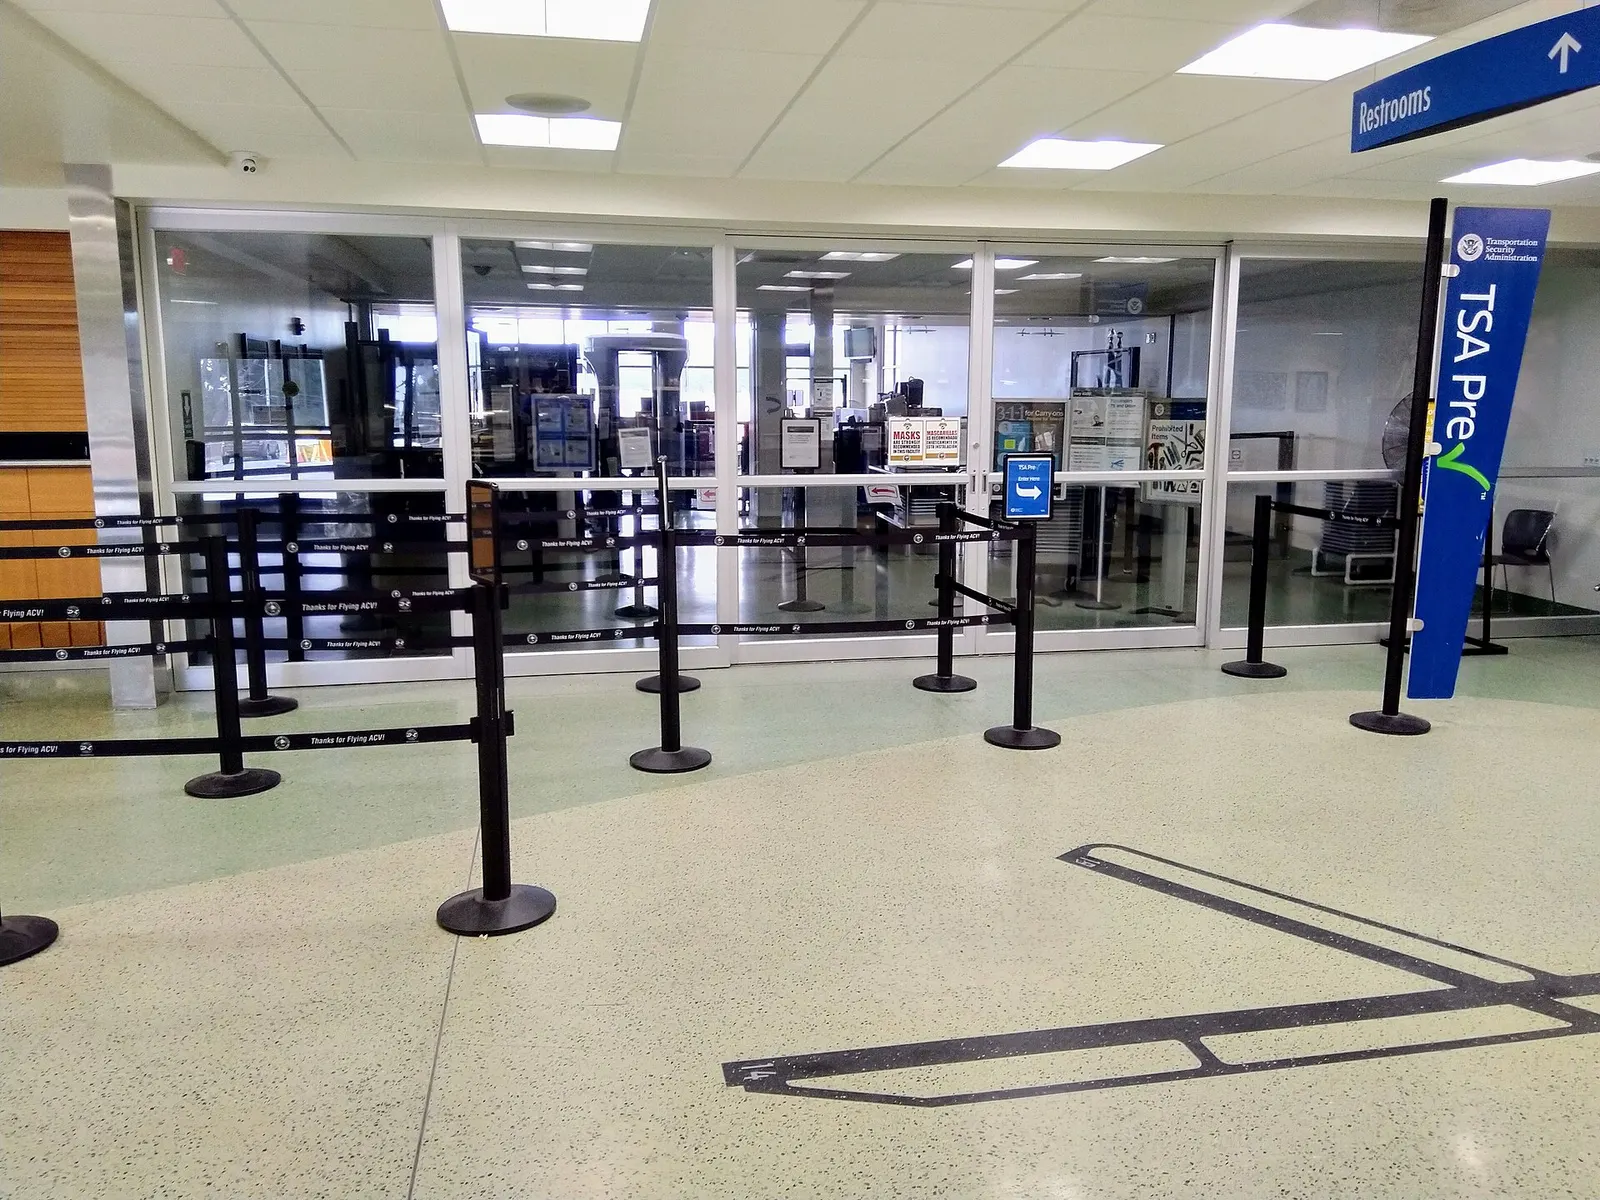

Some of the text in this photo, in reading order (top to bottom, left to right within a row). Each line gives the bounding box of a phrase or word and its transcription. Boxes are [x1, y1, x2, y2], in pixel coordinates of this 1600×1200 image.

[1359, 86, 1431, 134] Restrooms
[1486, 237, 1538, 247] Transportation
[1485, 246, 1516, 255] Security
[1484, 253, 1538, 262] Administration
[1454, 284, 1496, 363] TSA
[1446, 375, 1487, 440] Pre
[996, 405, 1025, 421] 3-1-1
[1024, 409, 1034, 417] for
[1152, 424, 1184, 432] Prohibited
[893, 431, 921, 440] MASKS
[302, 601, 378, 611] Thanks for Flying ACV!
[3, 609, 44, 619] Flying ACV!
[353, 640, 368, 648] Flying
[311, 733, 386, 745] Thanks for Flying ACV!
[17, 745, 39, 755] Flying
[40, 745, 58, 753] ACV!
